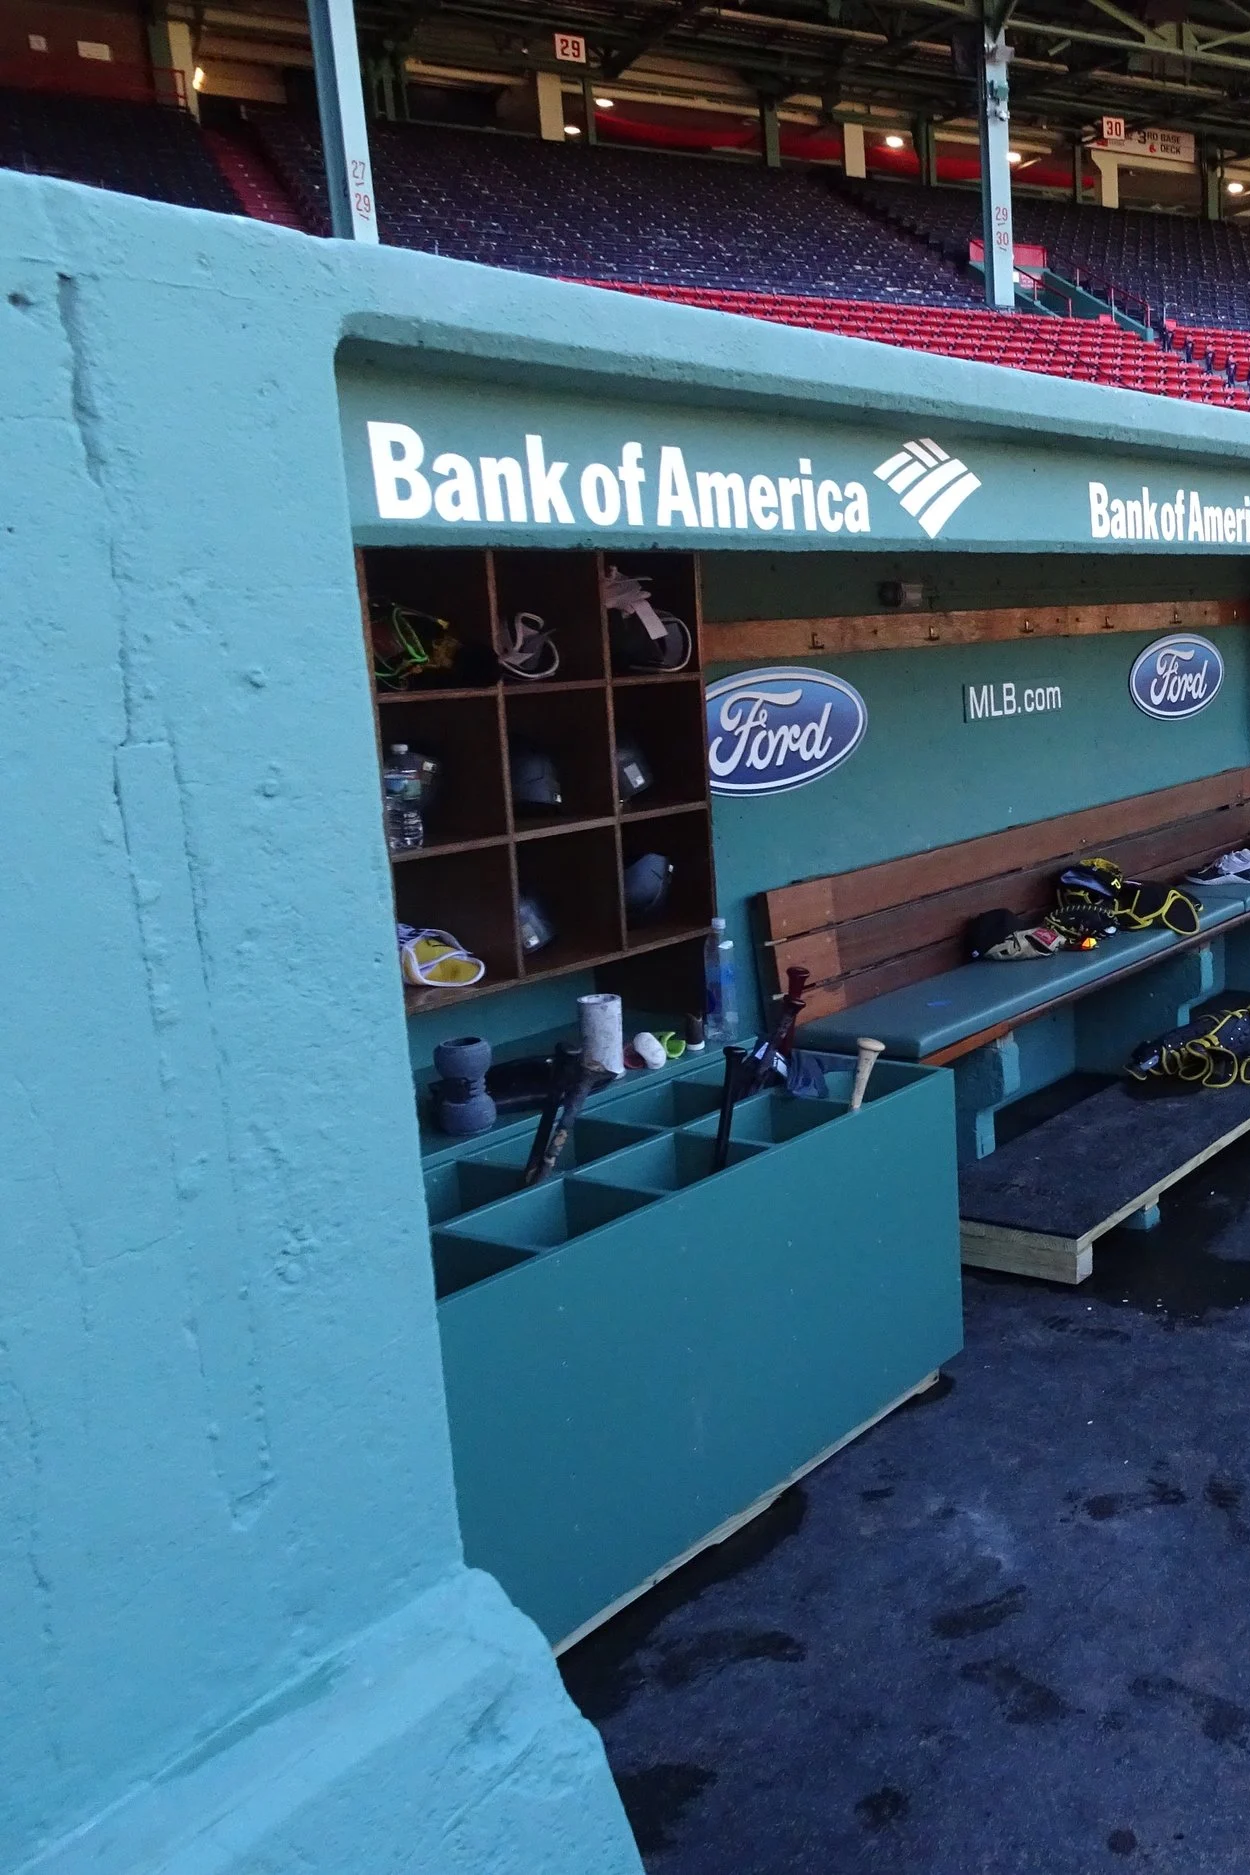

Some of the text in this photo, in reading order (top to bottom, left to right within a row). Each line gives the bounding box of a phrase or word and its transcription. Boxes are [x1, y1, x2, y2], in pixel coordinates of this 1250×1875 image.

[560, 38, 580, 58] 29
[1106, 120, 1121, 136] 30
[1160, 144, 1181, 155] DECK
[351, 160, 365, 179] 27
[355, 193, 371, 212] 29
[995, 206, 1008, 221] 29
[996, 231, 1009, 246] 30
[367, 421, 871, 534] Bank of America
[1088, 481, 1159, 540] Bank
[1160, 489, 1185, 541] of
[1150, 648, 1208, 707] Ford
[968, 683, 1062, 720] MLB.com
[709, 688, 833, 777] Ford
